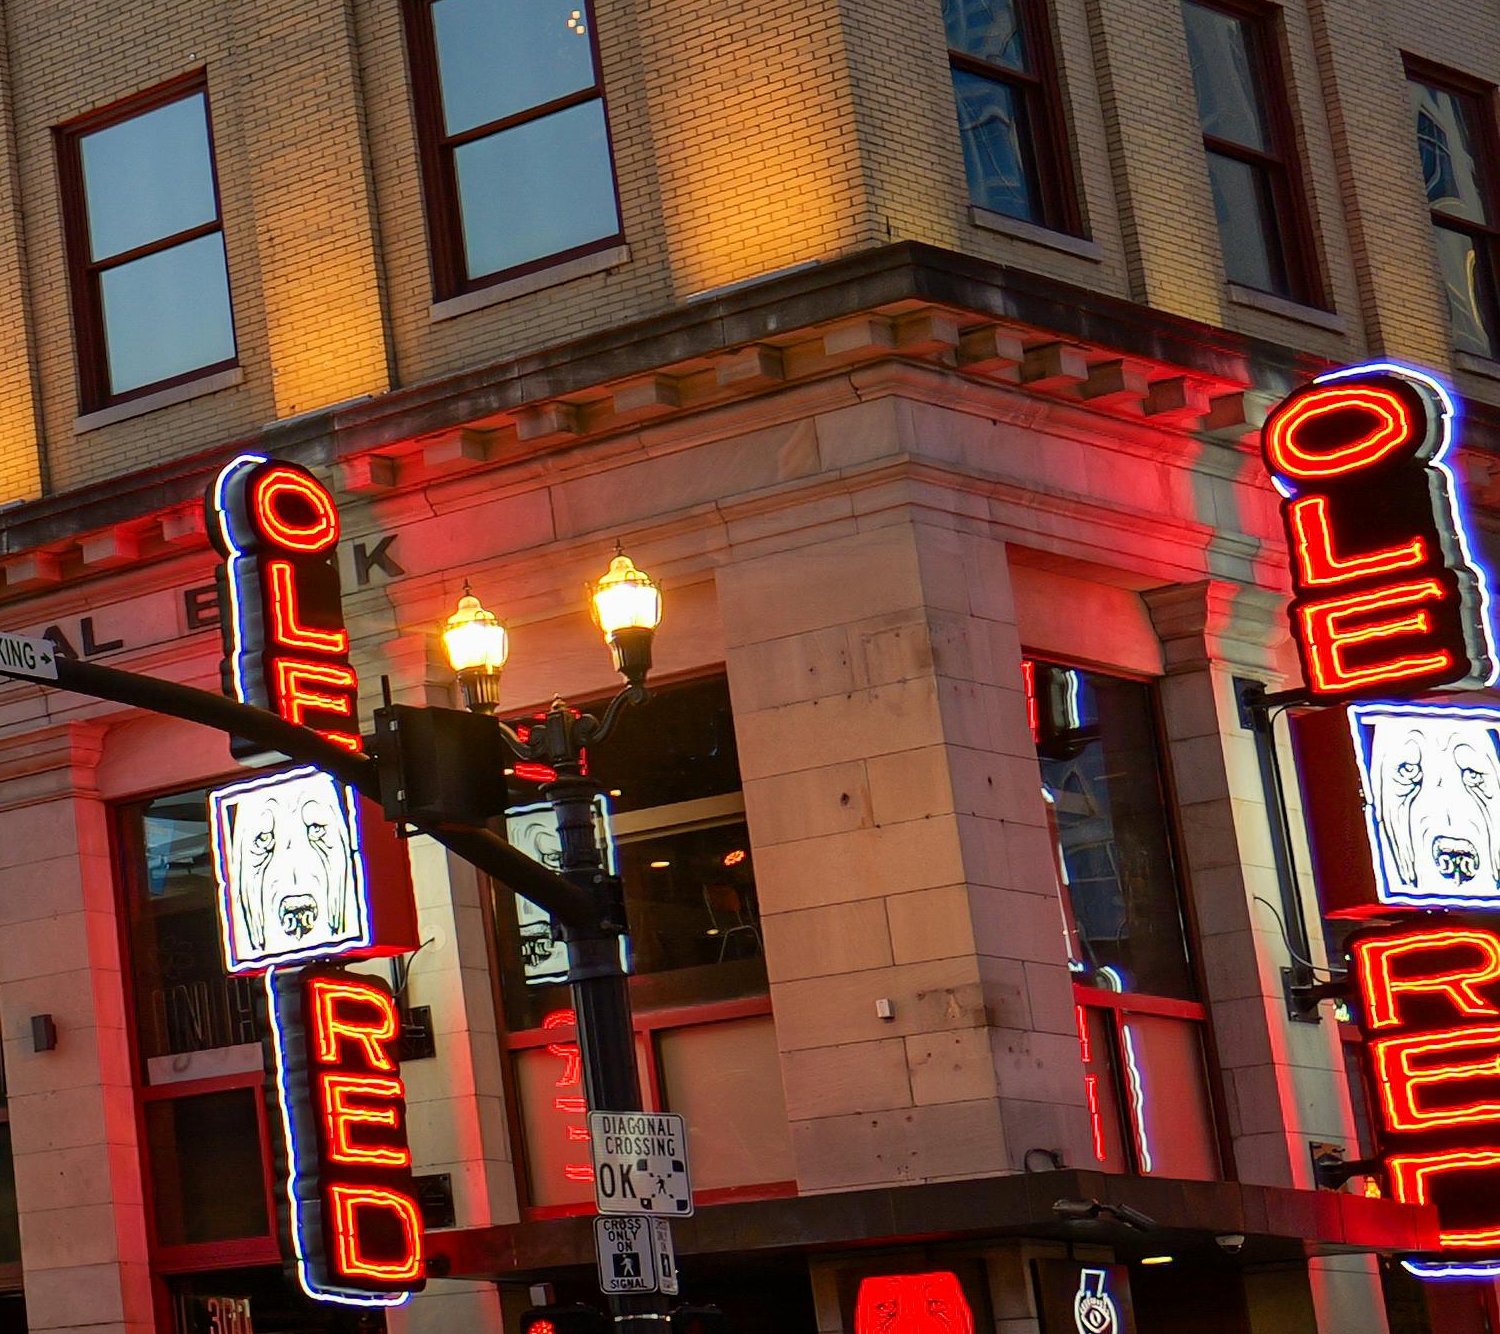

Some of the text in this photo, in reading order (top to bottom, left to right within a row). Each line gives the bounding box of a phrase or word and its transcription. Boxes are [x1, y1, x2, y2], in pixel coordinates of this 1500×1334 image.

[1270, 387, 1452, 693] OLE
[306, 978, 426, 1283] RED
[602, 1116, 676, 1137] DIAGONAL
[605, 1136, 676, 1157] CROSSING
[599, 1162, 637, 1198] OK
[603, 1218, 642, 1231] CROSS
[608, 1229, 639, 1242] ONLY
[616, 1241, 633, 1253] ON
[610, 1277, 648, 1289] SIGNAL
